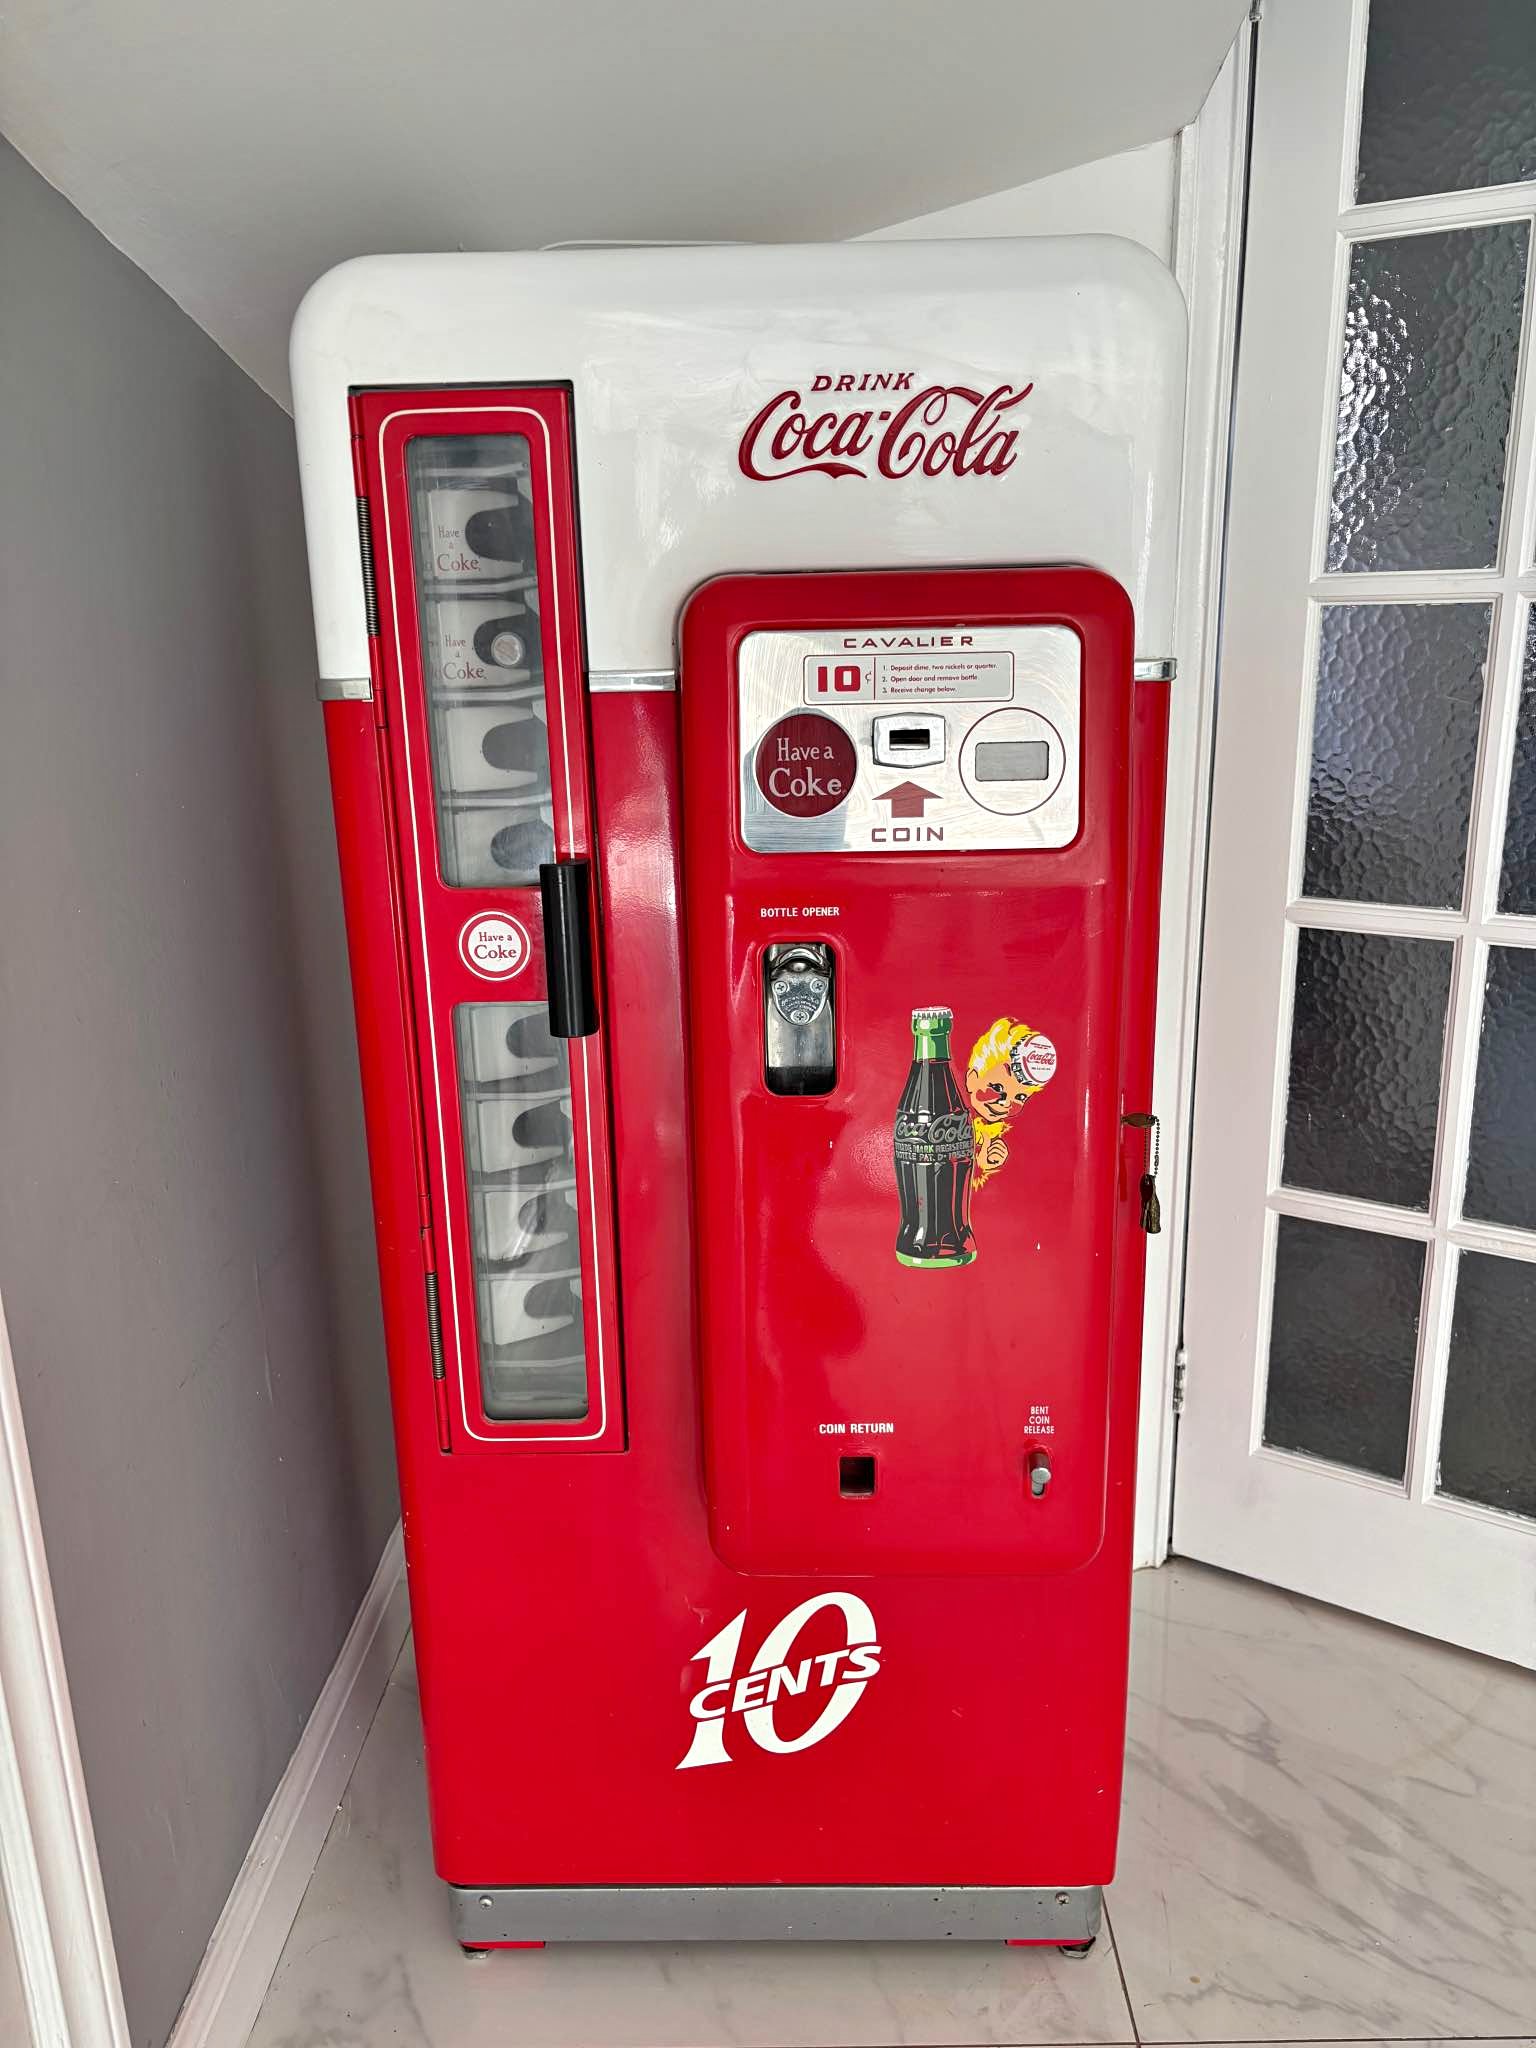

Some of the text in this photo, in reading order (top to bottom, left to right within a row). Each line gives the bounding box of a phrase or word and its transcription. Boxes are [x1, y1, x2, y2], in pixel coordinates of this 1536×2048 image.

[811, 372, 914, 391] DRINK
[738, 383, 1033, 481] Coca-Cola
[438, 526, 460, 538] Have
[445, 635, 466, 647] Have
[843, 636, 973, 648] CAVALIER
[777, 738, 834, 761] Have a
[769, 766, 842, 798] Coke
[871, 826, 944, 843] COIN
[760, 906, 840, 917] BOTTLE OPENER
[479, 931, 504, 942] Have
[474, 944, 517, 959] Coke
[1030, 1406, 1049, 1415] BENT
[1028, 1416, 1050, 1424] COIN
[819, 1422, 894, 1434] COIN RETURN
[1023, 1425, 1055, 1434] RELEASE
[675, 1591, 877, 1770] 10
[689, 1645, 882, 1719] CENTS
